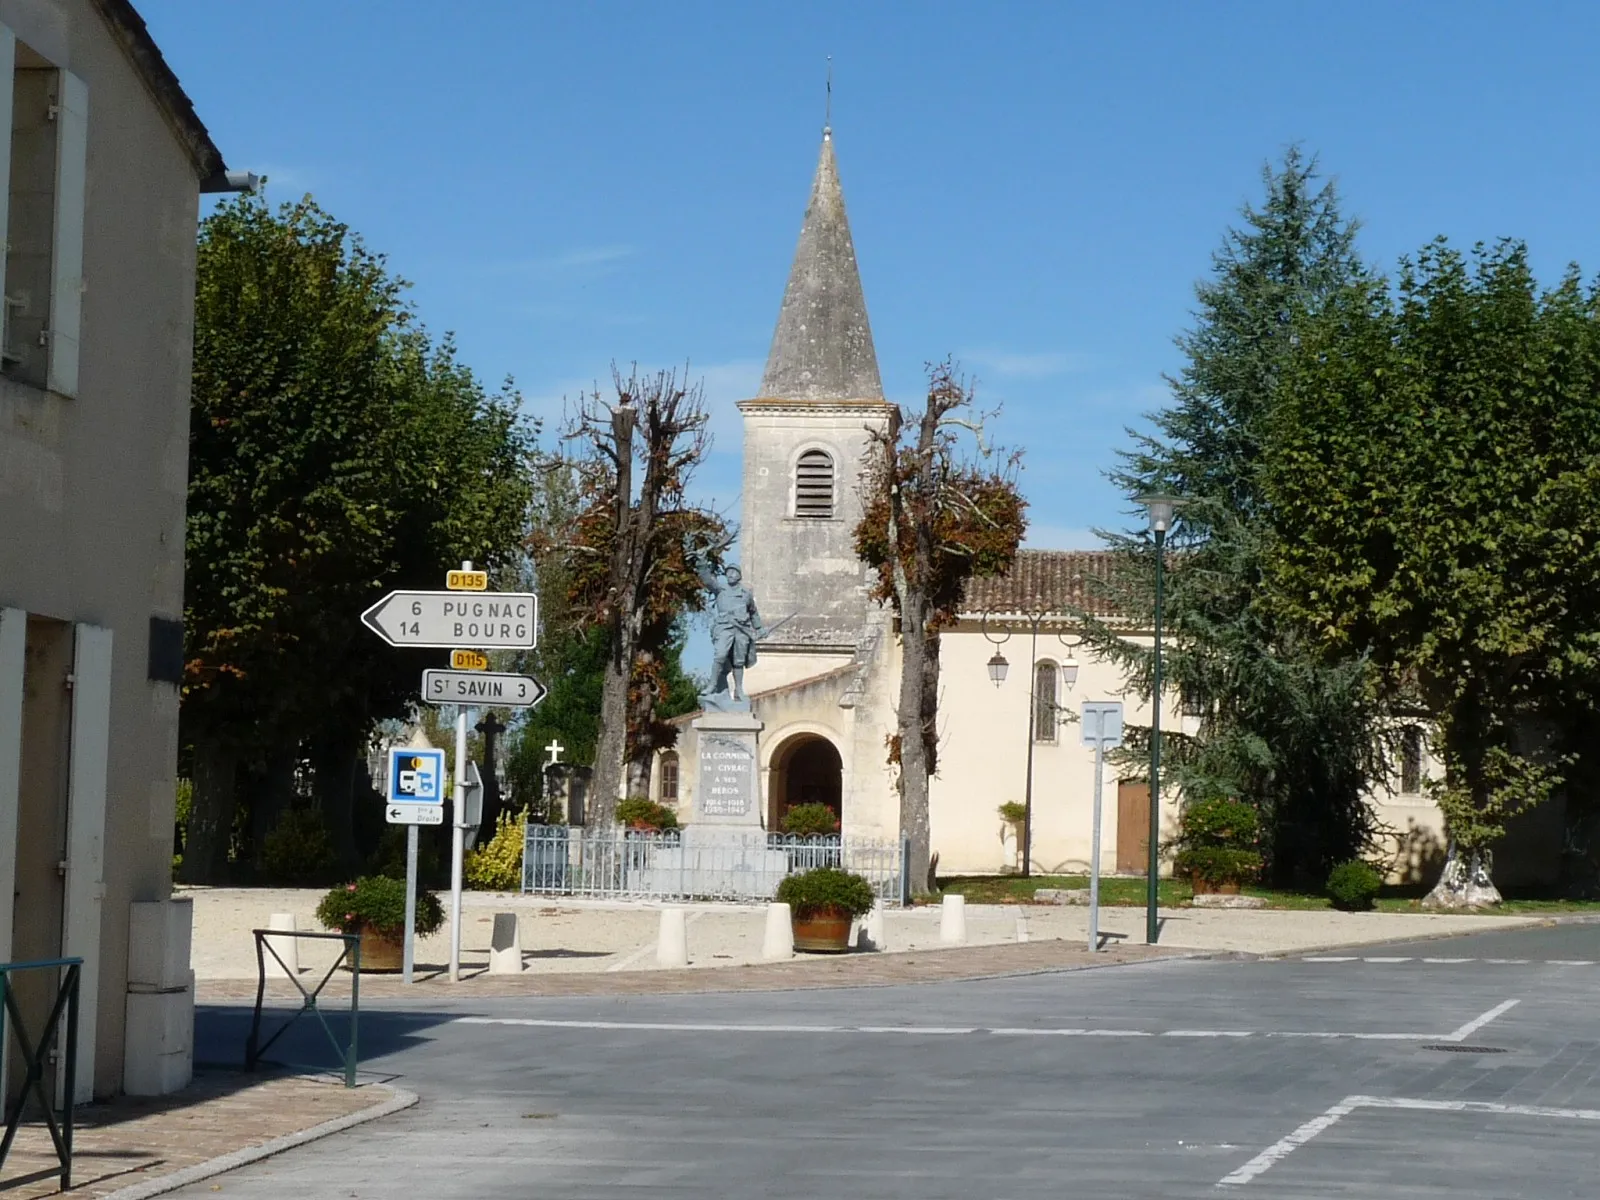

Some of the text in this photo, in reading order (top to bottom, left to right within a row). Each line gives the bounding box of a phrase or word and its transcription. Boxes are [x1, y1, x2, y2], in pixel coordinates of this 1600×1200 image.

[411, 601, 527, 618] 6 PUGNAC
[399, 621, 527, 638] 14 BOURG
[457, 680, 503, 697] SAVIN
[517, 683, 527, 698] 3
[701, 752, 711, 760] LA
[718, 764, 749, 772] CIVRAC
